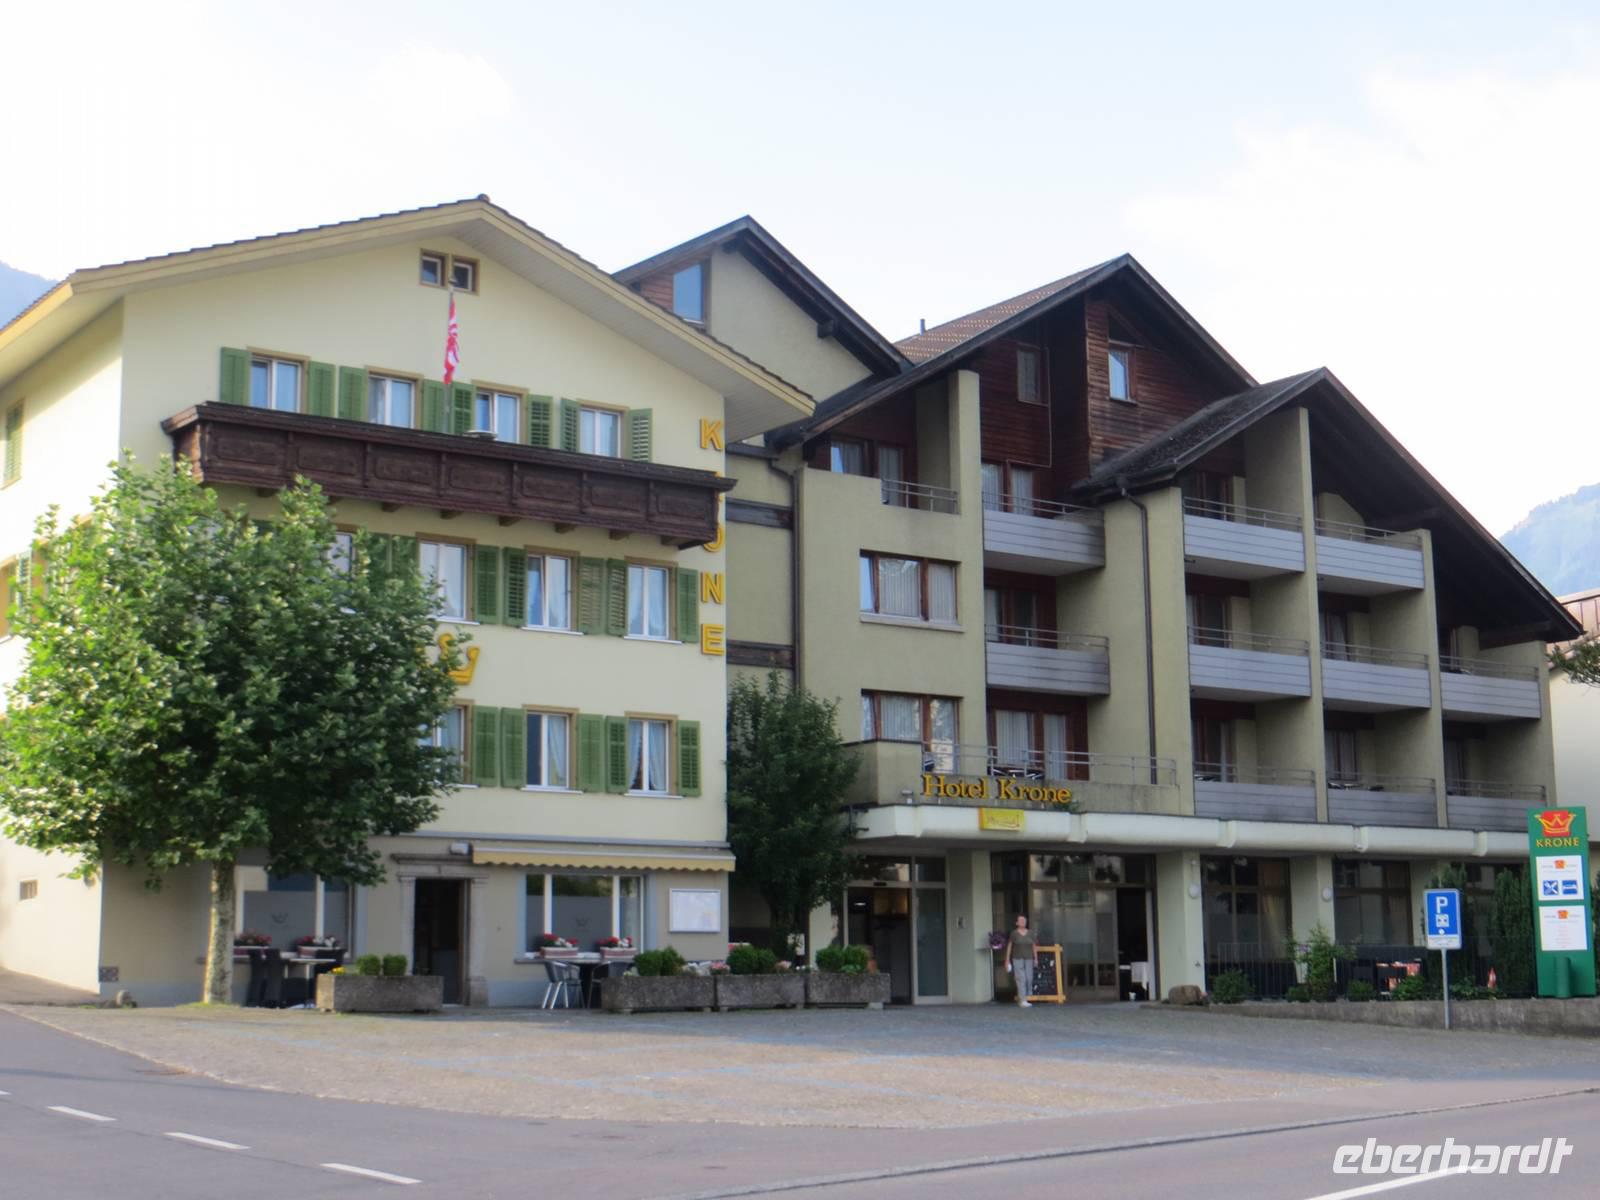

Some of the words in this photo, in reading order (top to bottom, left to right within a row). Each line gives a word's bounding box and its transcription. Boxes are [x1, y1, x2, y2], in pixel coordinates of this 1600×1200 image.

[922, 774, 987, 799] Hotel
[996, 778, 1072, 803] Krone
[1535, 837, 1580, 848] KRONE
[1436, 896, 1448, 914] P
